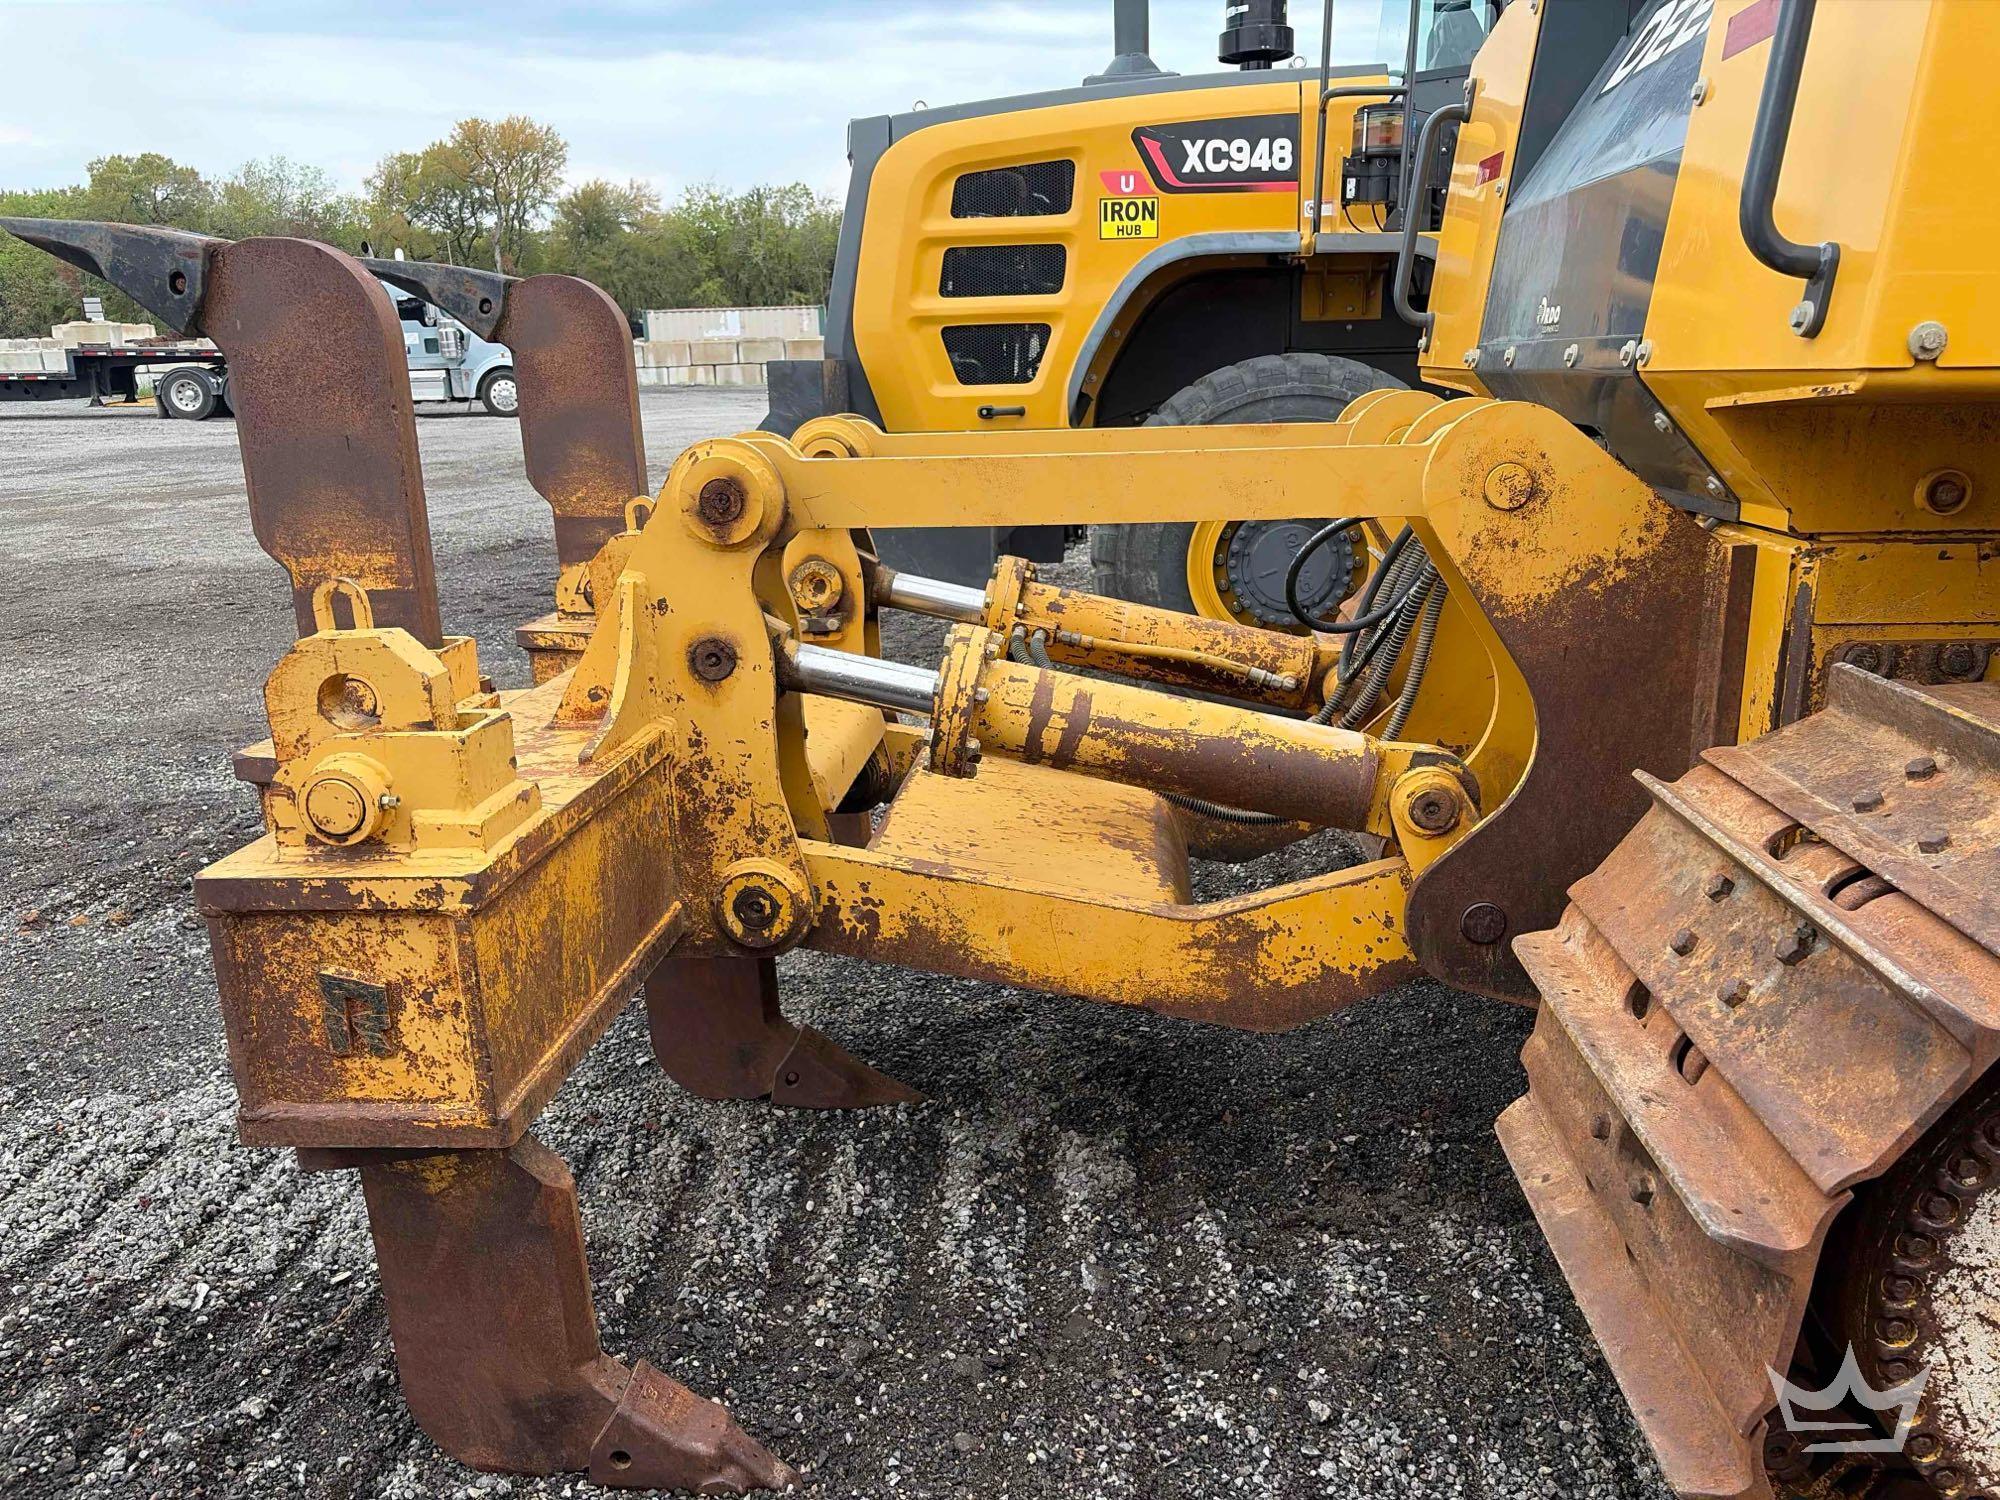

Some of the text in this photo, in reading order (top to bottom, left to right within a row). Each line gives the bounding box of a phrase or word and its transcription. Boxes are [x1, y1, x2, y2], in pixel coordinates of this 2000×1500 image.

[1600, 0, 1715, 94] DEE
[1181, 138, 1293, 173] XC948
[1120, 175, 1135, 193] U
[1103, 201, 1155, 222] IRON
[1116, 225, 1141, 236] HUB
